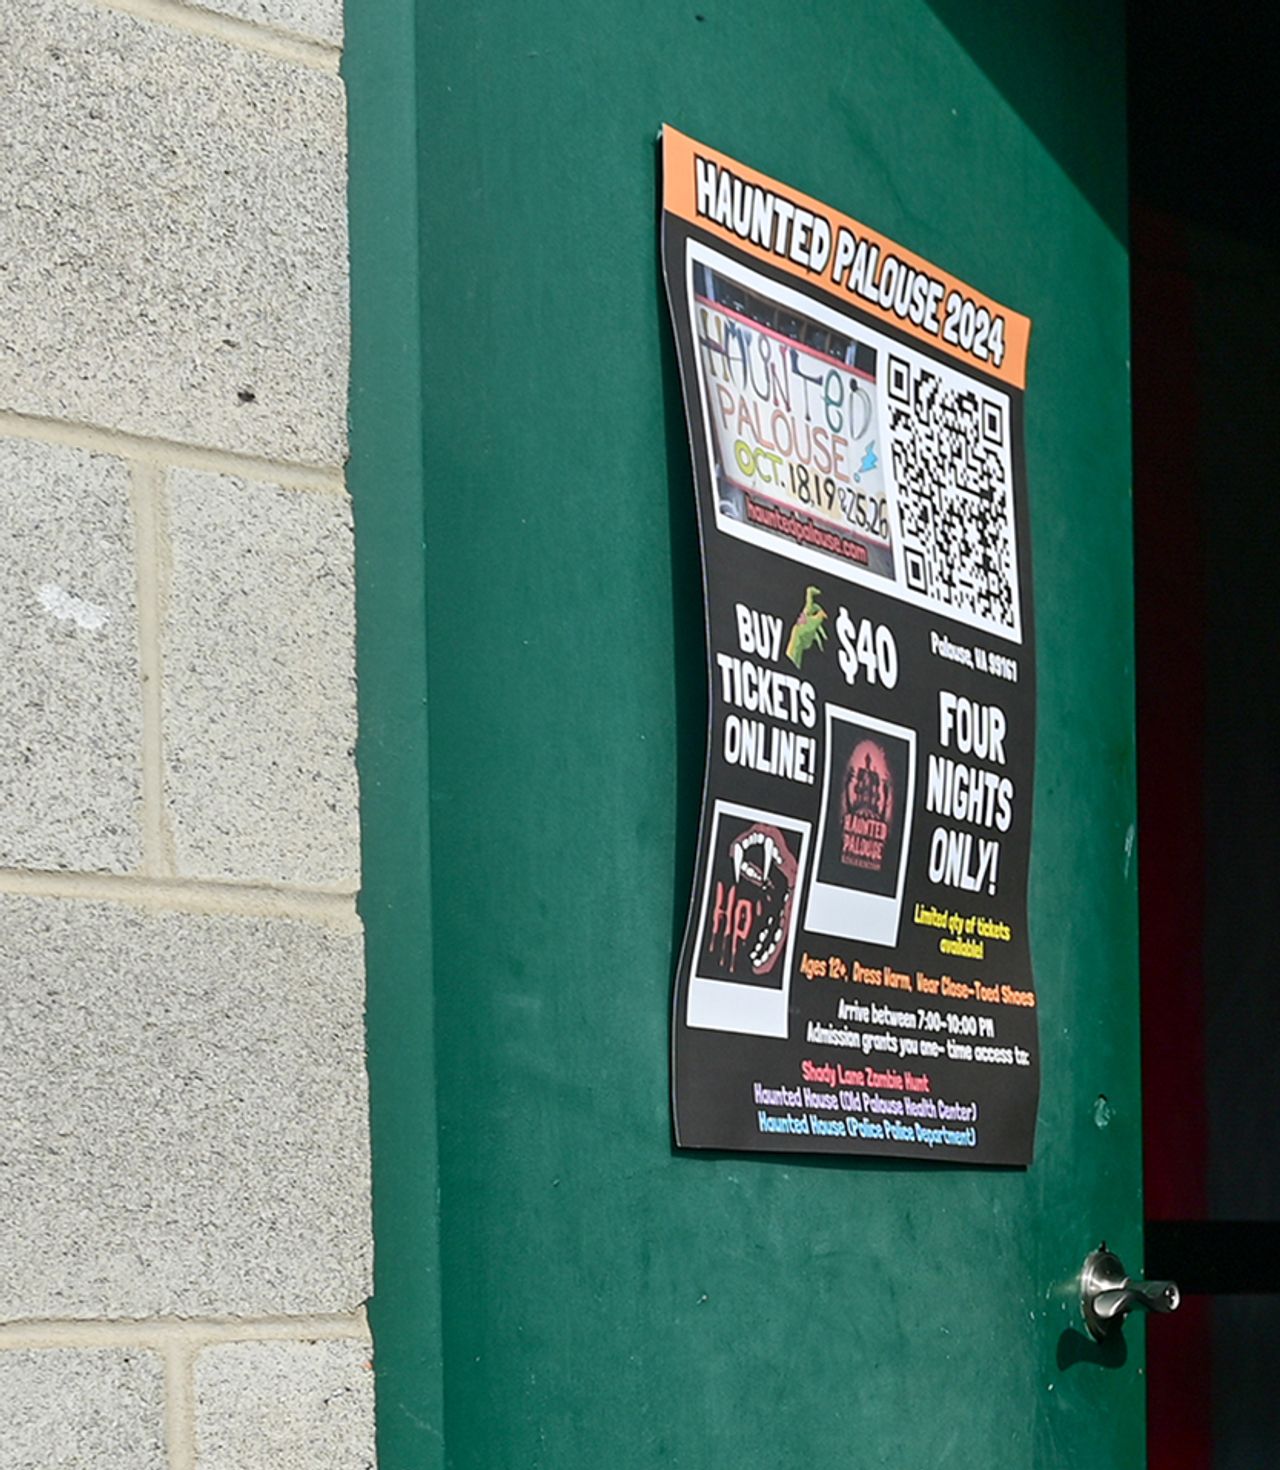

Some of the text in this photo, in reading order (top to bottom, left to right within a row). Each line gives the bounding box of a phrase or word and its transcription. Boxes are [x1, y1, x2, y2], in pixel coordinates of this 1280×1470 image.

[696, 157, 1006, 368] HAUNTED PALOUSE 2024
[746, 497, 869, 566] hauntedpalouse.com
[735, 603, 783, 662] BUY
[835, 605, 898, 690] $40
[930, 631, 975, 671] Palouse,
[716, 652, 817, 729] TICKETS
[723, 714, 817, 786] ONLINE!
[938, 690, 1007, 765] FOUR
[926, 754, 1014, 833] NIGHTS
[928, 826, 1000, 896] ONLY!
[913, 902, 1011, 941] Limited qty of tickets
[939, 937, 985, 960] available!
[799, 952, 827, 980] Ages
[852, 960, 882, 987] Dress
[883, 965, 913, 993] Warm,
[915, 971, 940, 995] Wear
[940, 975, 1000, 1004] Close-Toed
[1000, 984, 1035, 1008] Shoes
[806, 1020, 861, 1049] Admission
[861, 1031, 898, 1055] grants
[898, 1037, 919, 1058] you
[946, 1037, 973, 1061] time
[974, 1046, 1014, 1065] access
[1013, 1045, 1031, 1066] to:
[837, 997, 869, 1022] Arrive
[870, 1002, 917, 1030] between
[978, 1017, 995, 1038] PM
[753, 1082, 978, 1123] Haunted House (Old Palouse Health Center)
[801, 1059, 931, 1093] Shady Lane Zombie Hunt
[757, 1110, 808, 1136] Haunted
[810, 1114, 847, 1137] House
[884, 1118, 916, 1142] Police
[914, 1121, 977, 1148] Department)
